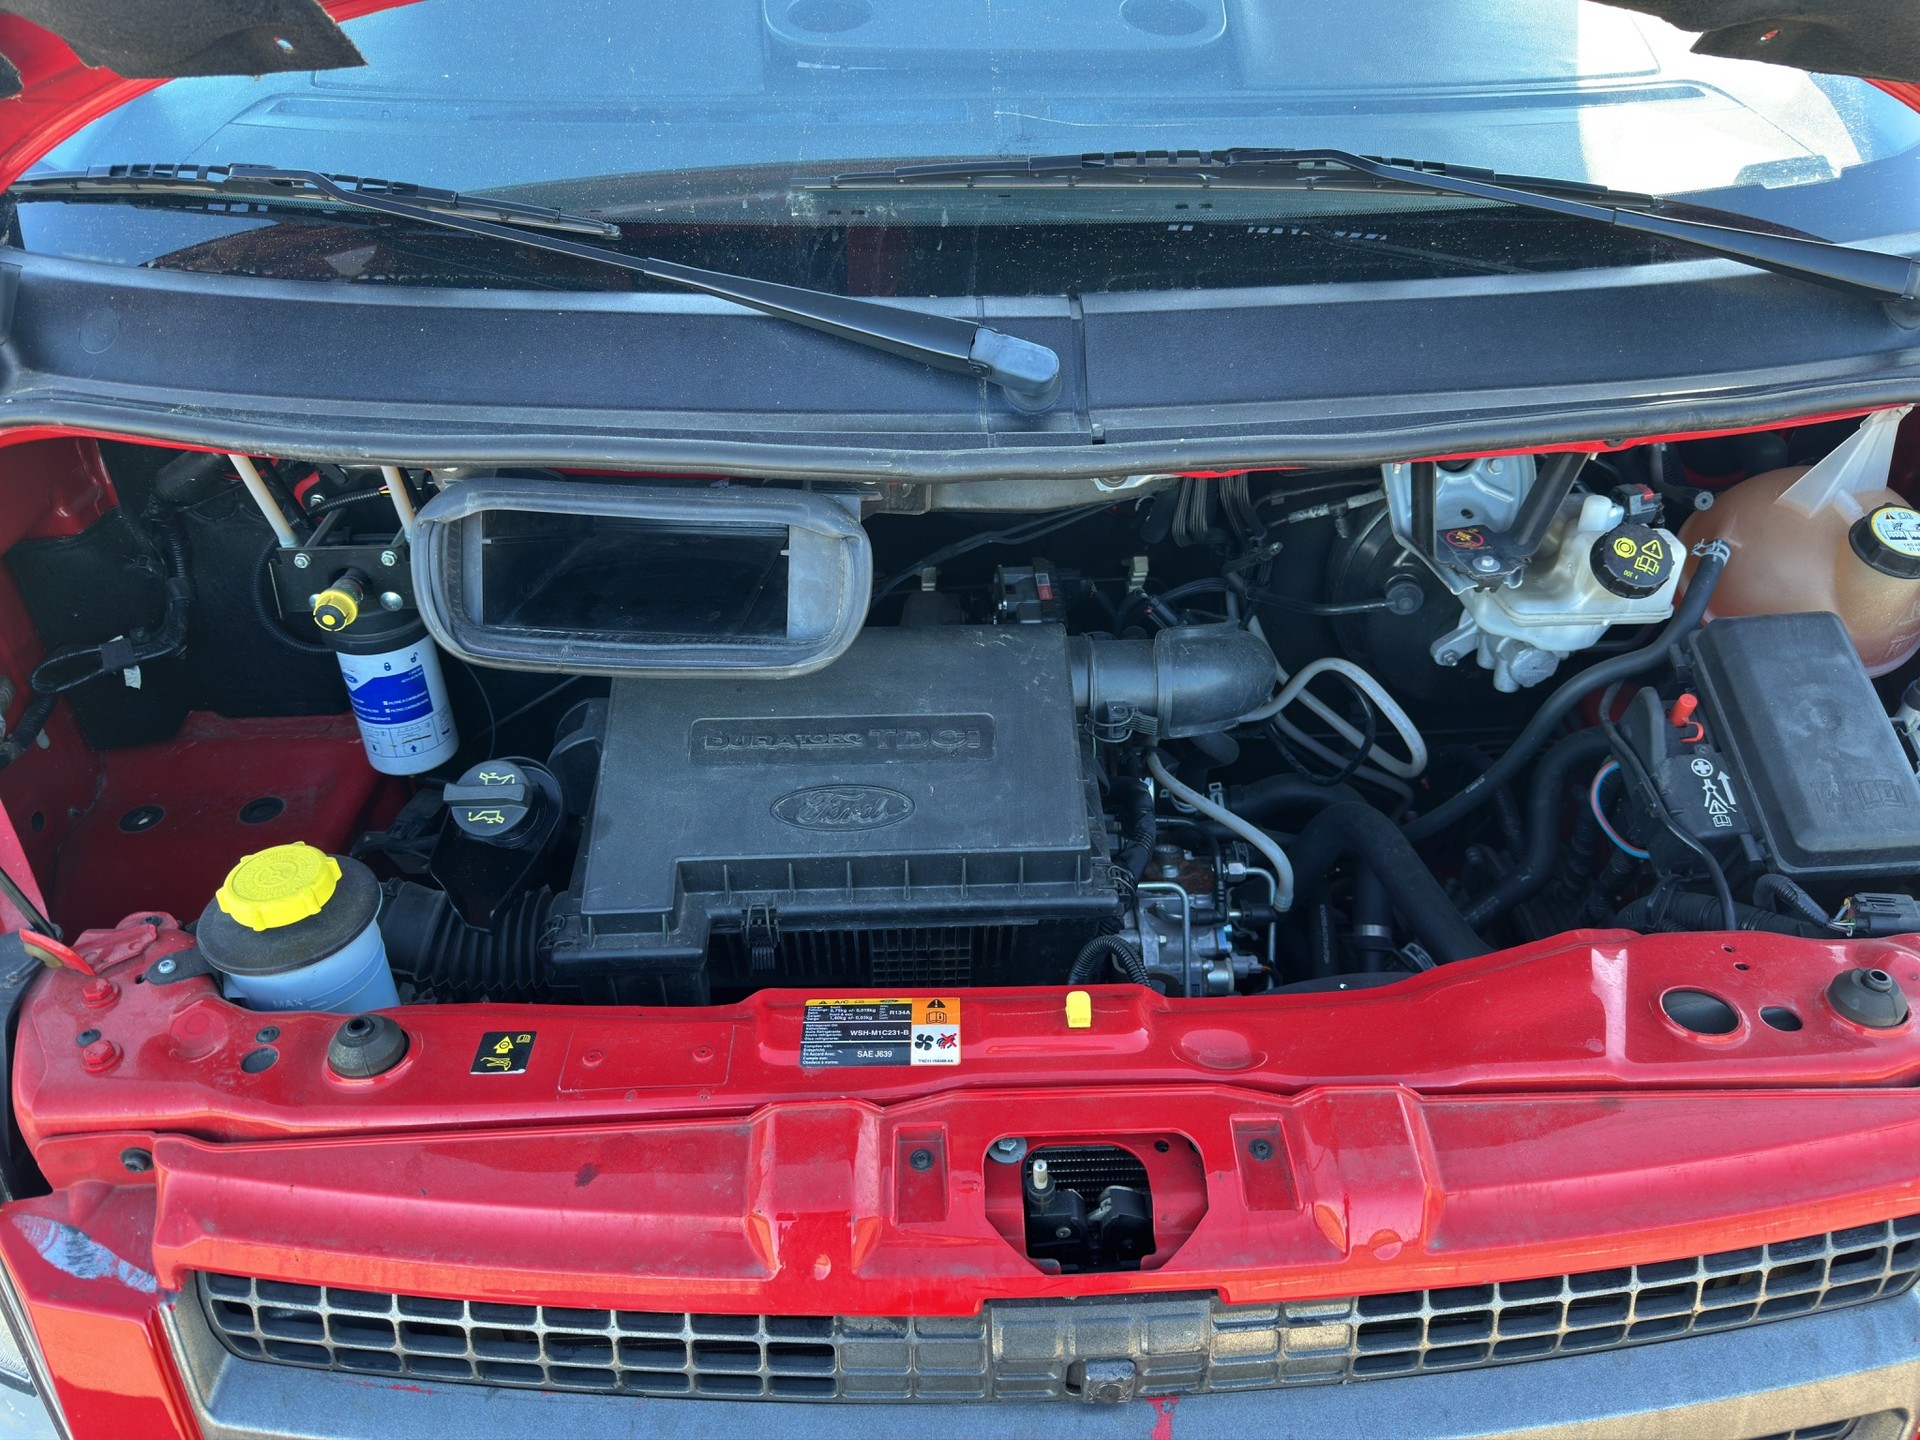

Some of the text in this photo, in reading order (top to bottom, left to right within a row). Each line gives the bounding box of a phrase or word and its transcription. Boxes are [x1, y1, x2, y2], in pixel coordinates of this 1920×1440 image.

[795, 791, 891, 825] Ford
[272, 998, 304, 1008] MAX
[857, 1050, 893, 1058] SAE J639
